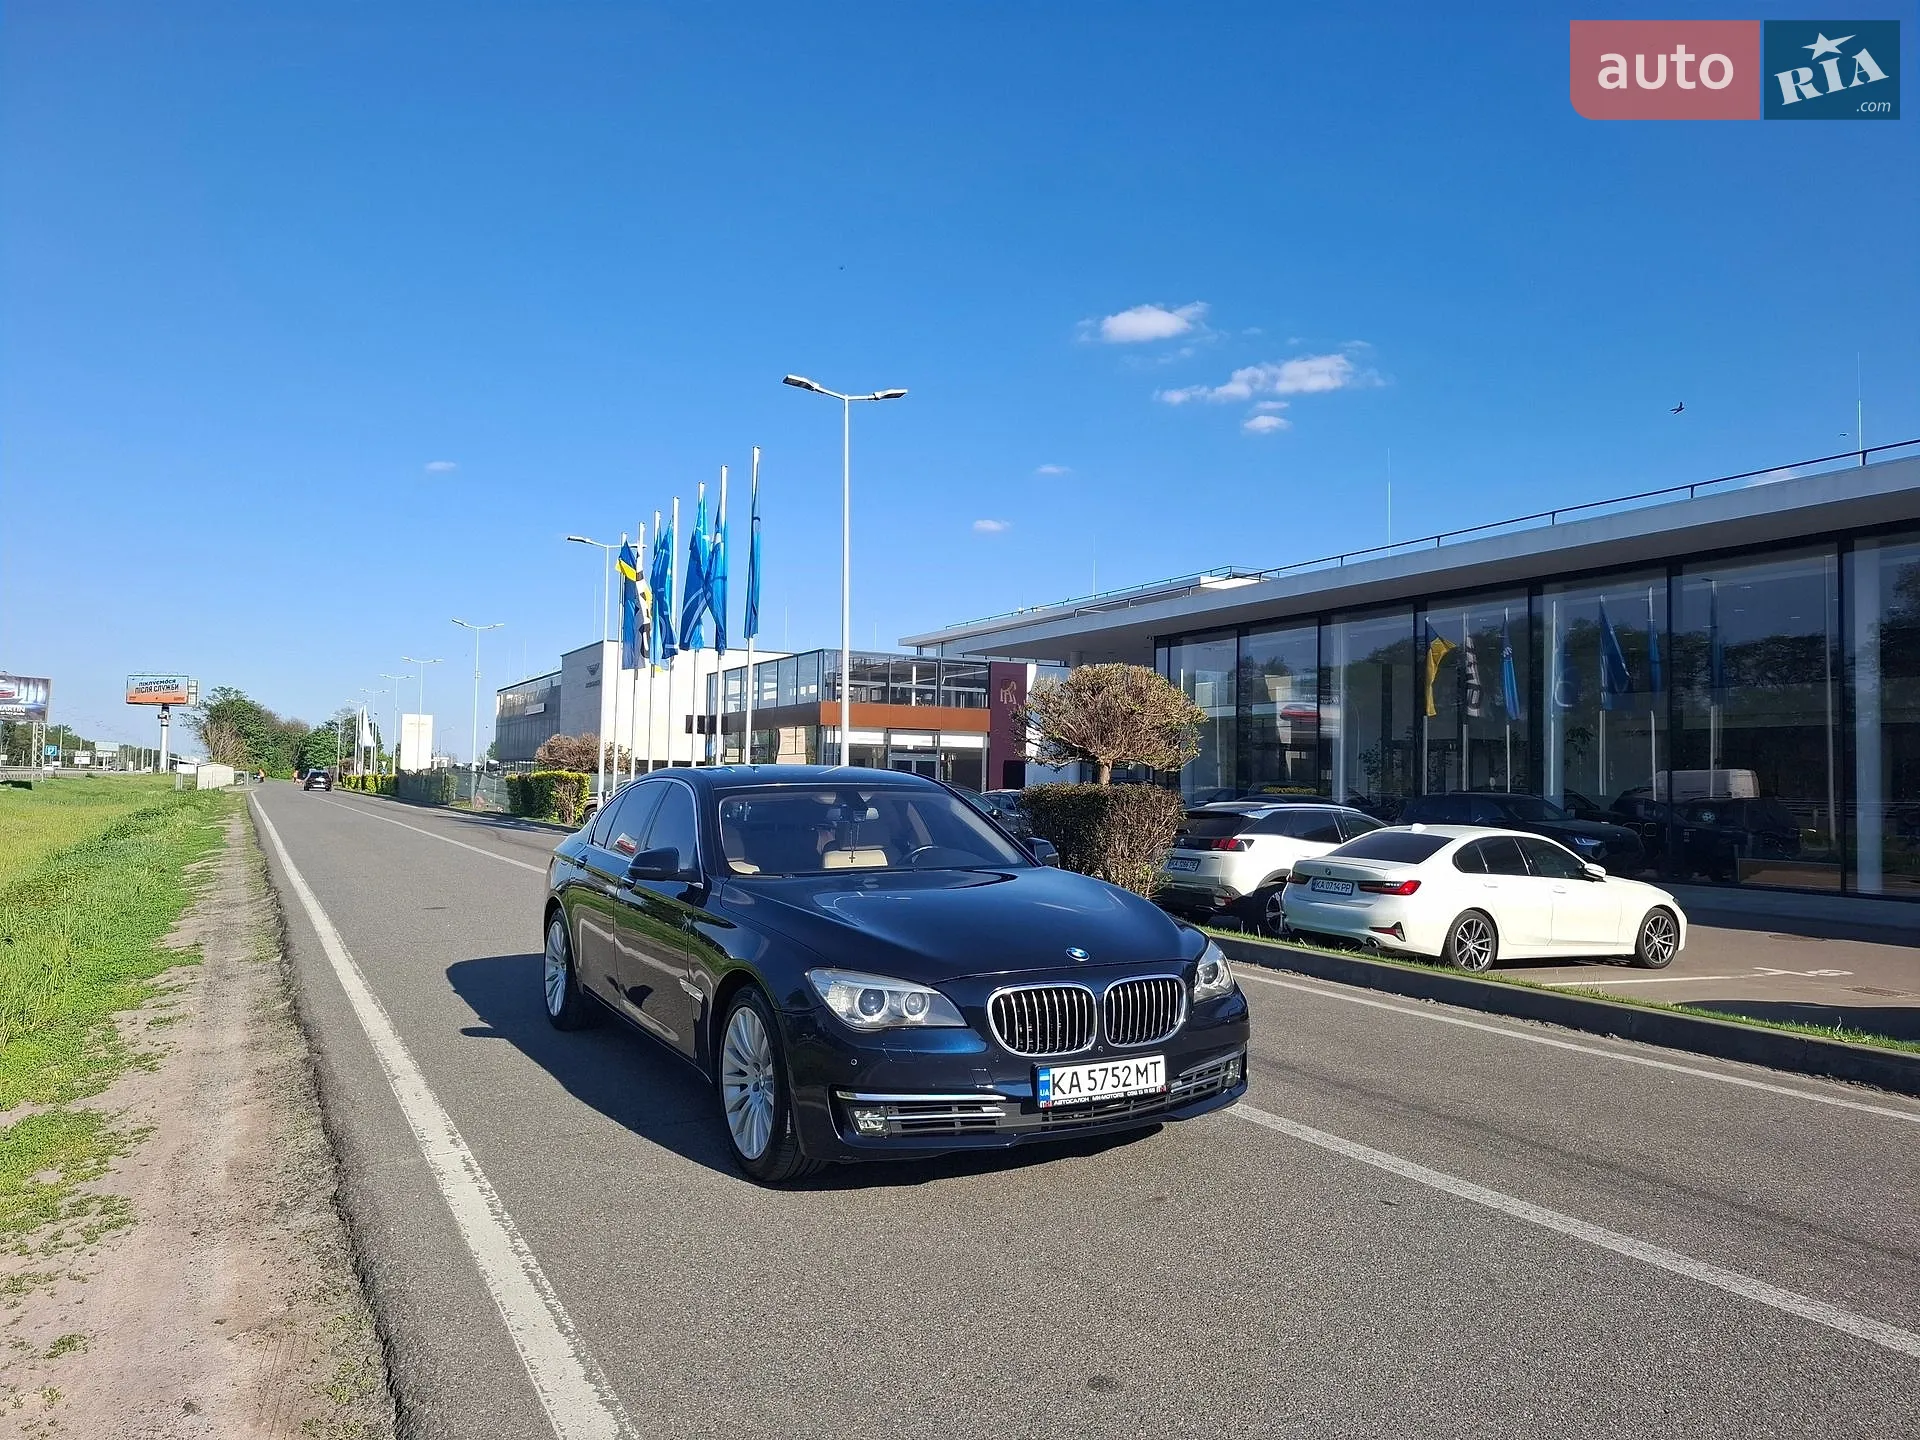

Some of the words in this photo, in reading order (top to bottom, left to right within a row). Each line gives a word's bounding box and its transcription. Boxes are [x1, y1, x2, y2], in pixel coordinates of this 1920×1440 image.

[1052, 1071, 1082, 1096] KA
[1087, 1066, 1132, 1092] 5752
[1135, 1061, 1161, 1086] MT
